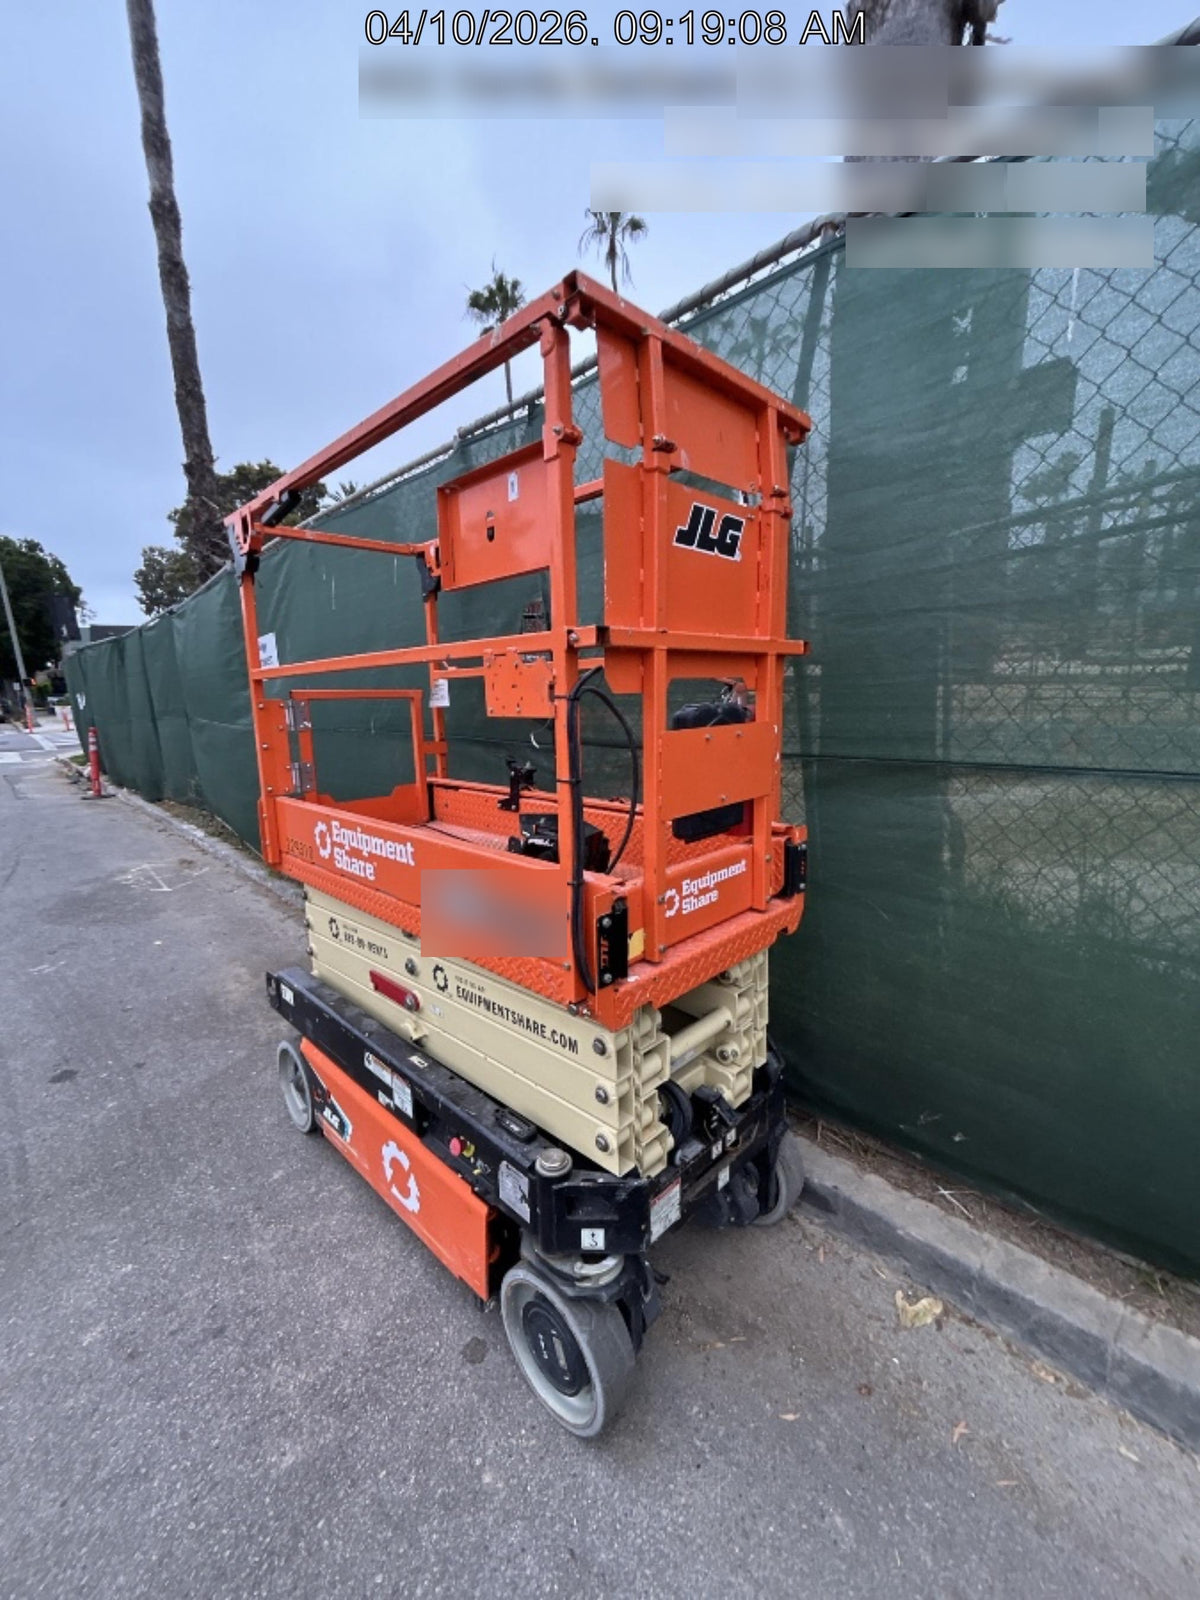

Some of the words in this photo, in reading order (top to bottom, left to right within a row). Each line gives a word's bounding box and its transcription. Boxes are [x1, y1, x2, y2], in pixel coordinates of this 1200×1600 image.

[672, 501, 746, 562] JLG
[331, 820, 416, 867] Equipment
[333, 846, 376, 881] Share
[682, 859, 747, 896] Equipment
[681, 889, 719, 916] Share
[456, 984, 580, 1055] EQUIPMENTSHARE.COM
